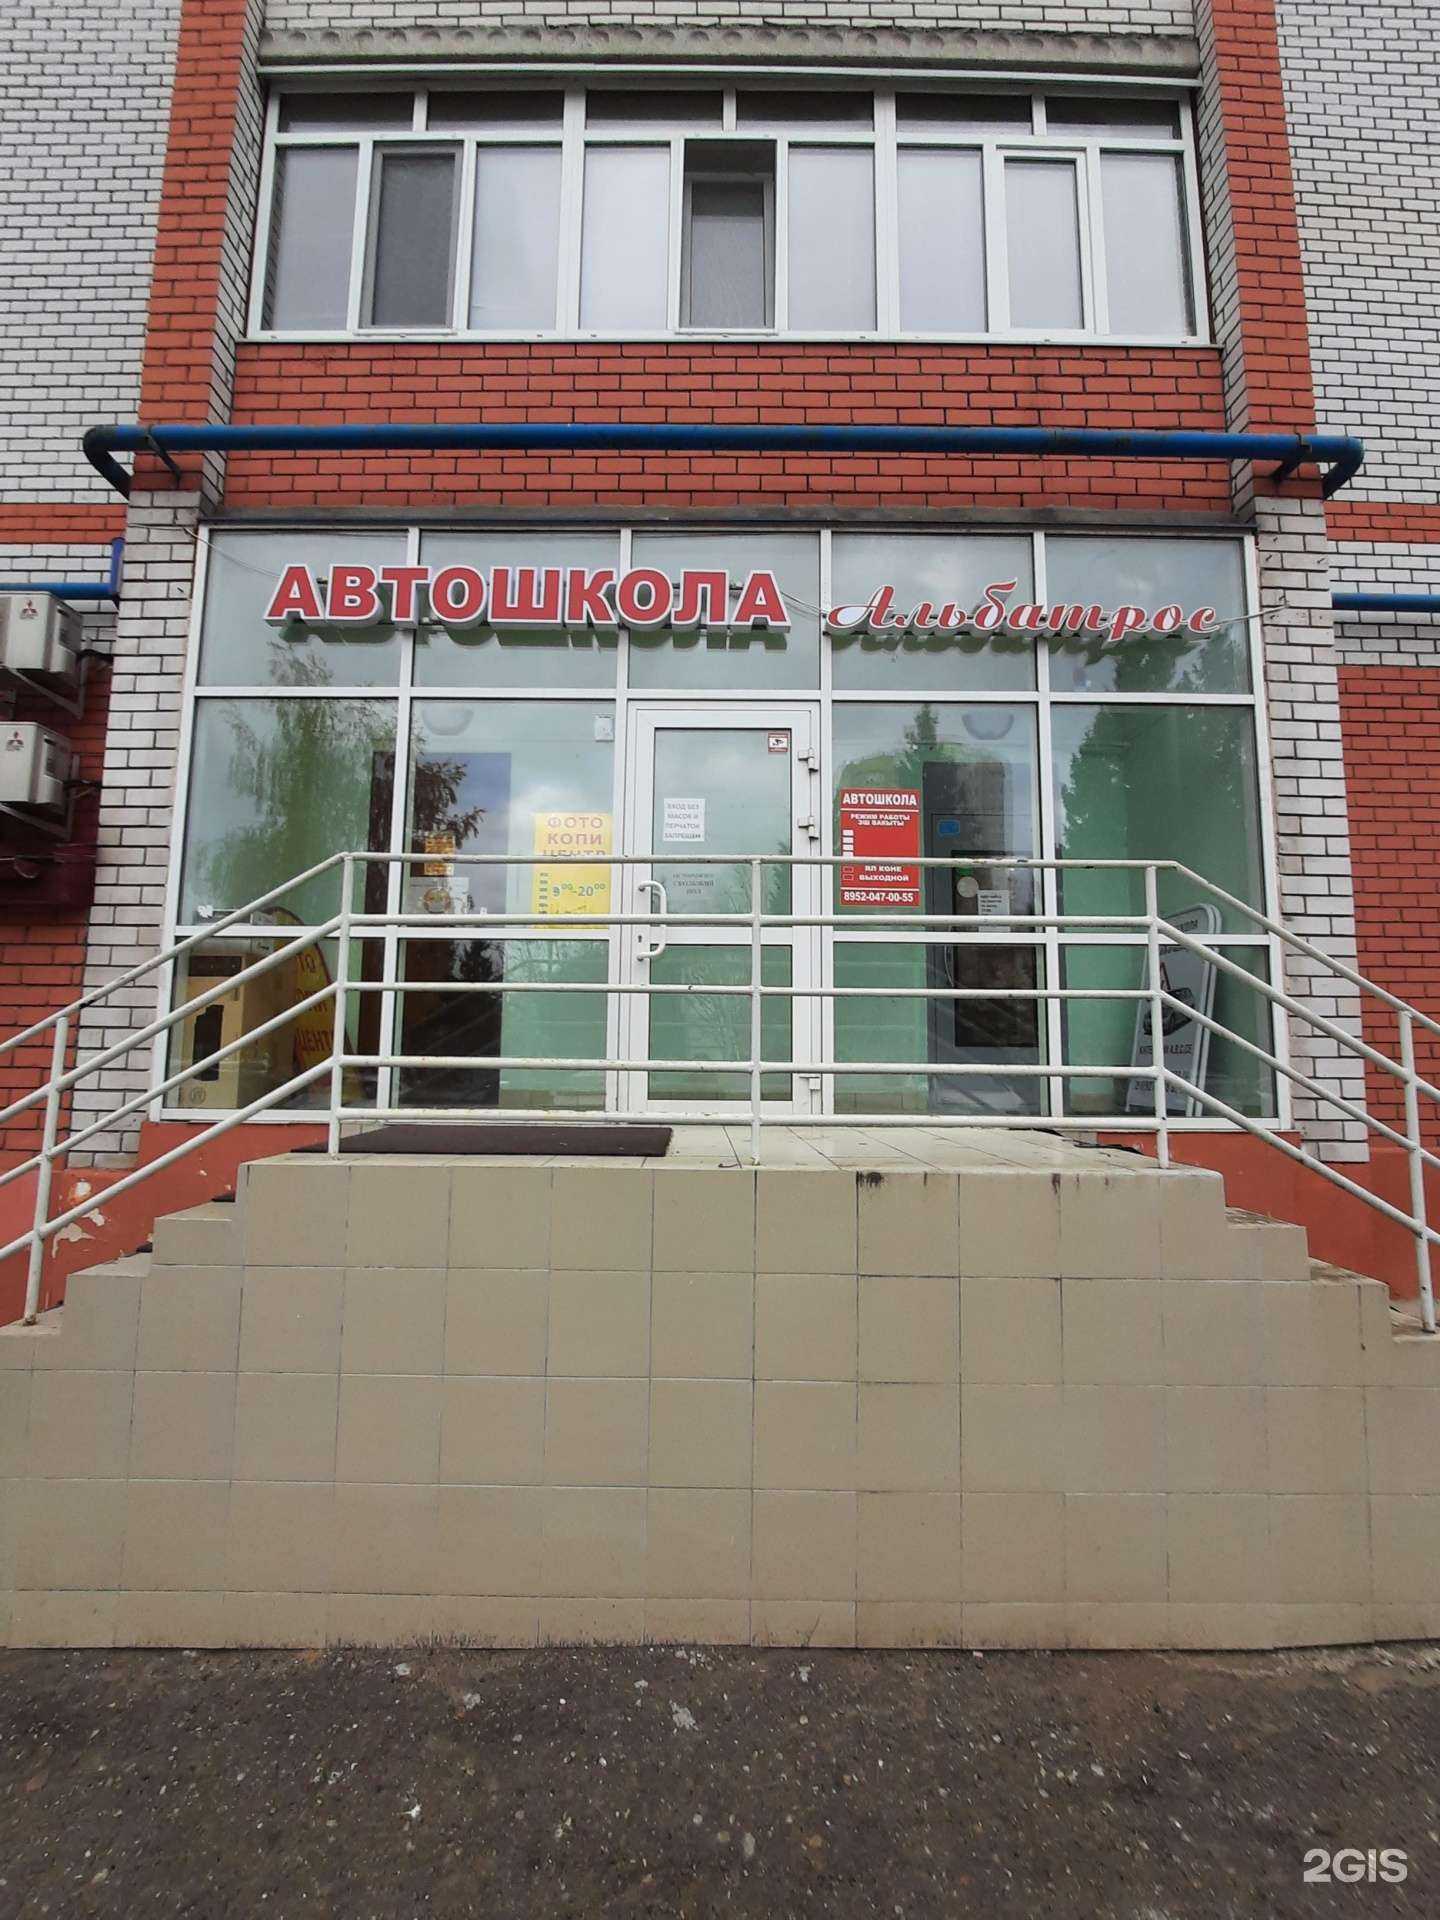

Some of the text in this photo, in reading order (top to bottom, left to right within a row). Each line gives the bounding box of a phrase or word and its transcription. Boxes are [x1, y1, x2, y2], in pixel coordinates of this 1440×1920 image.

[264, 565, 1220, 642] АВТОШКОЛА Альбатрос
[842, 793, 917, 806] АВТОШКОЛА
[547, 817, 603, 829] ФОТО
[547, 833, 602, 845] КОПИ
[858, 874, 910, 882] ВЫХОДНОЙ
[843, 891, 914, 902] 8952-047-00-55
